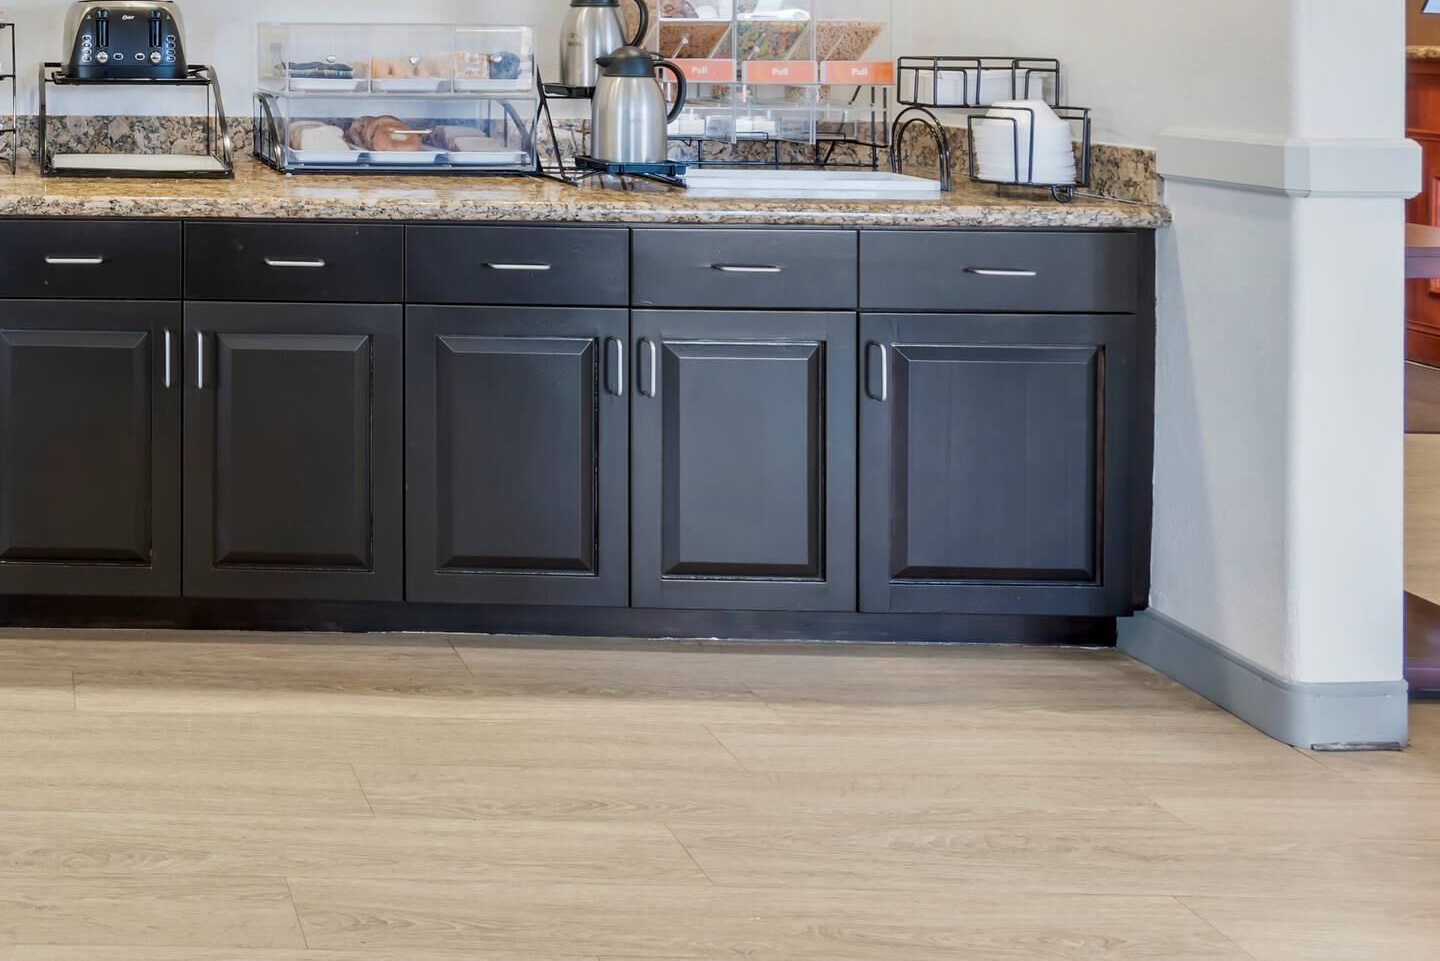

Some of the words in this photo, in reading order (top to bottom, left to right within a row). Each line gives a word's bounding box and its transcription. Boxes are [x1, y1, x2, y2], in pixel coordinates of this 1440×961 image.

[691, 66, 708, 75] Pull
[772, 68, 789, 77] Pull
[851, 68, 868, 77] Pull
